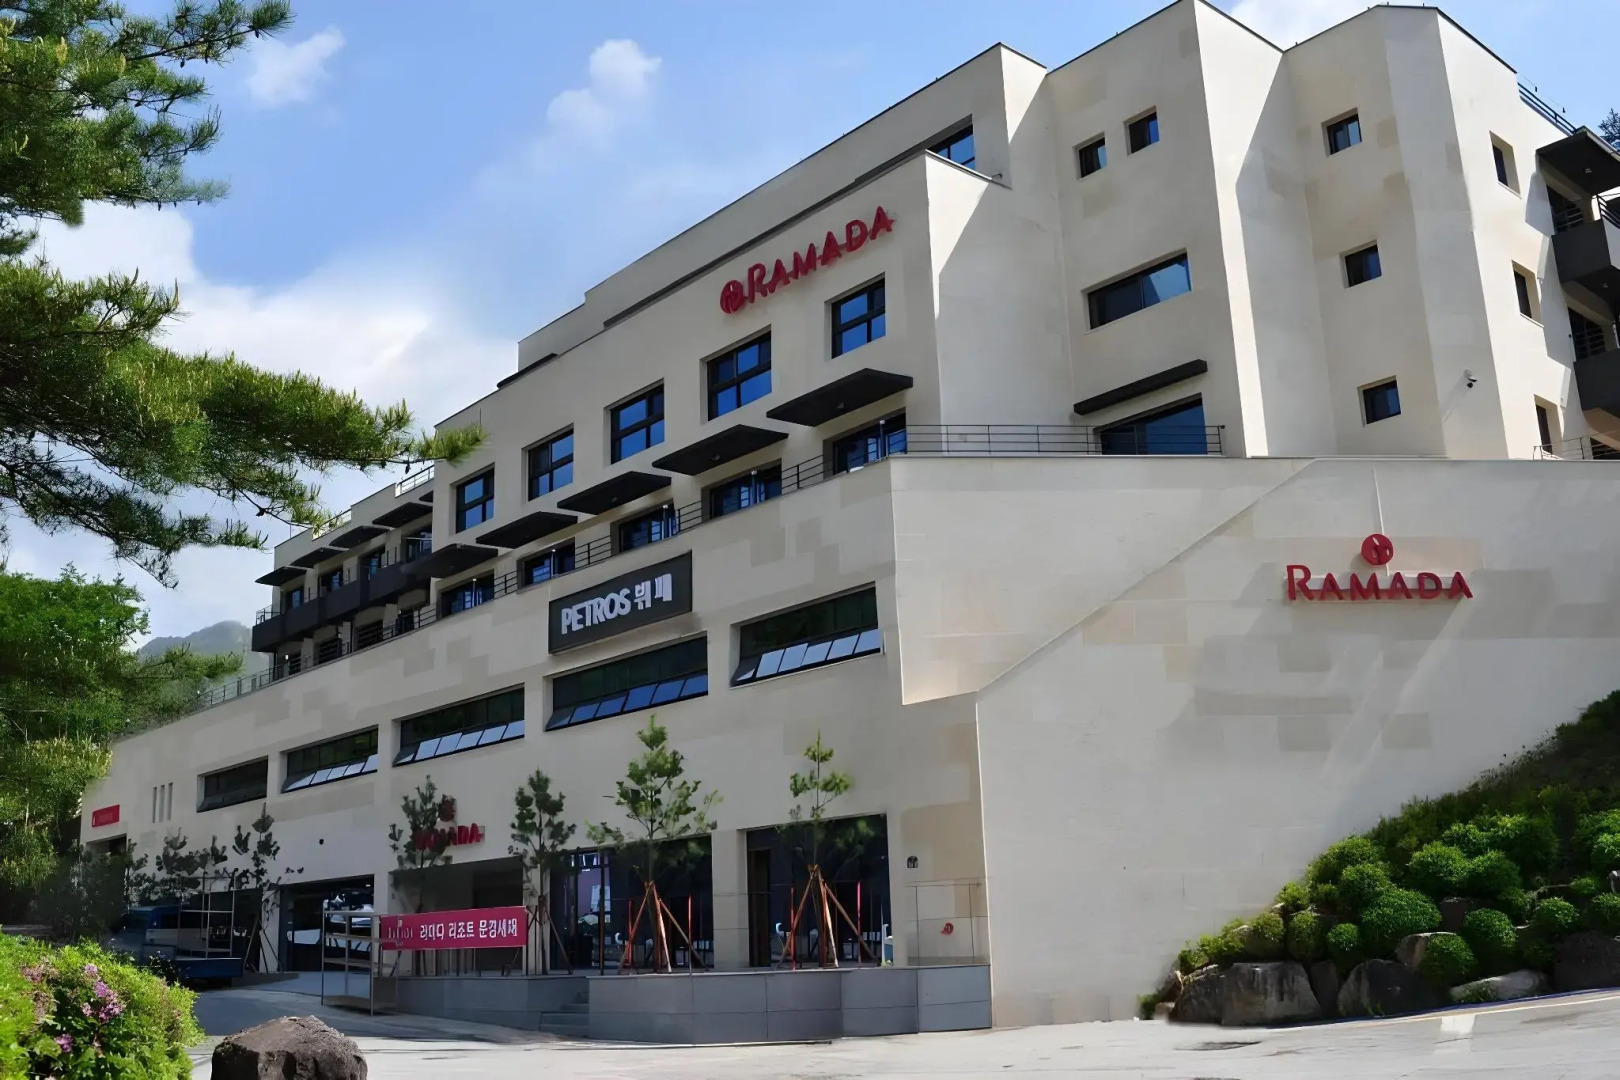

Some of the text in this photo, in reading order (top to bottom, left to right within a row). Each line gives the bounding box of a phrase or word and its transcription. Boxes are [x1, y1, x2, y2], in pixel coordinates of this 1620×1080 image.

[747, 205, 895, 304] RAMADA
[1286, 564, 1474, 601] RAMADA
[561, 587, 632, 635] PETROS
[448, 920, 475, 939] 리조트
